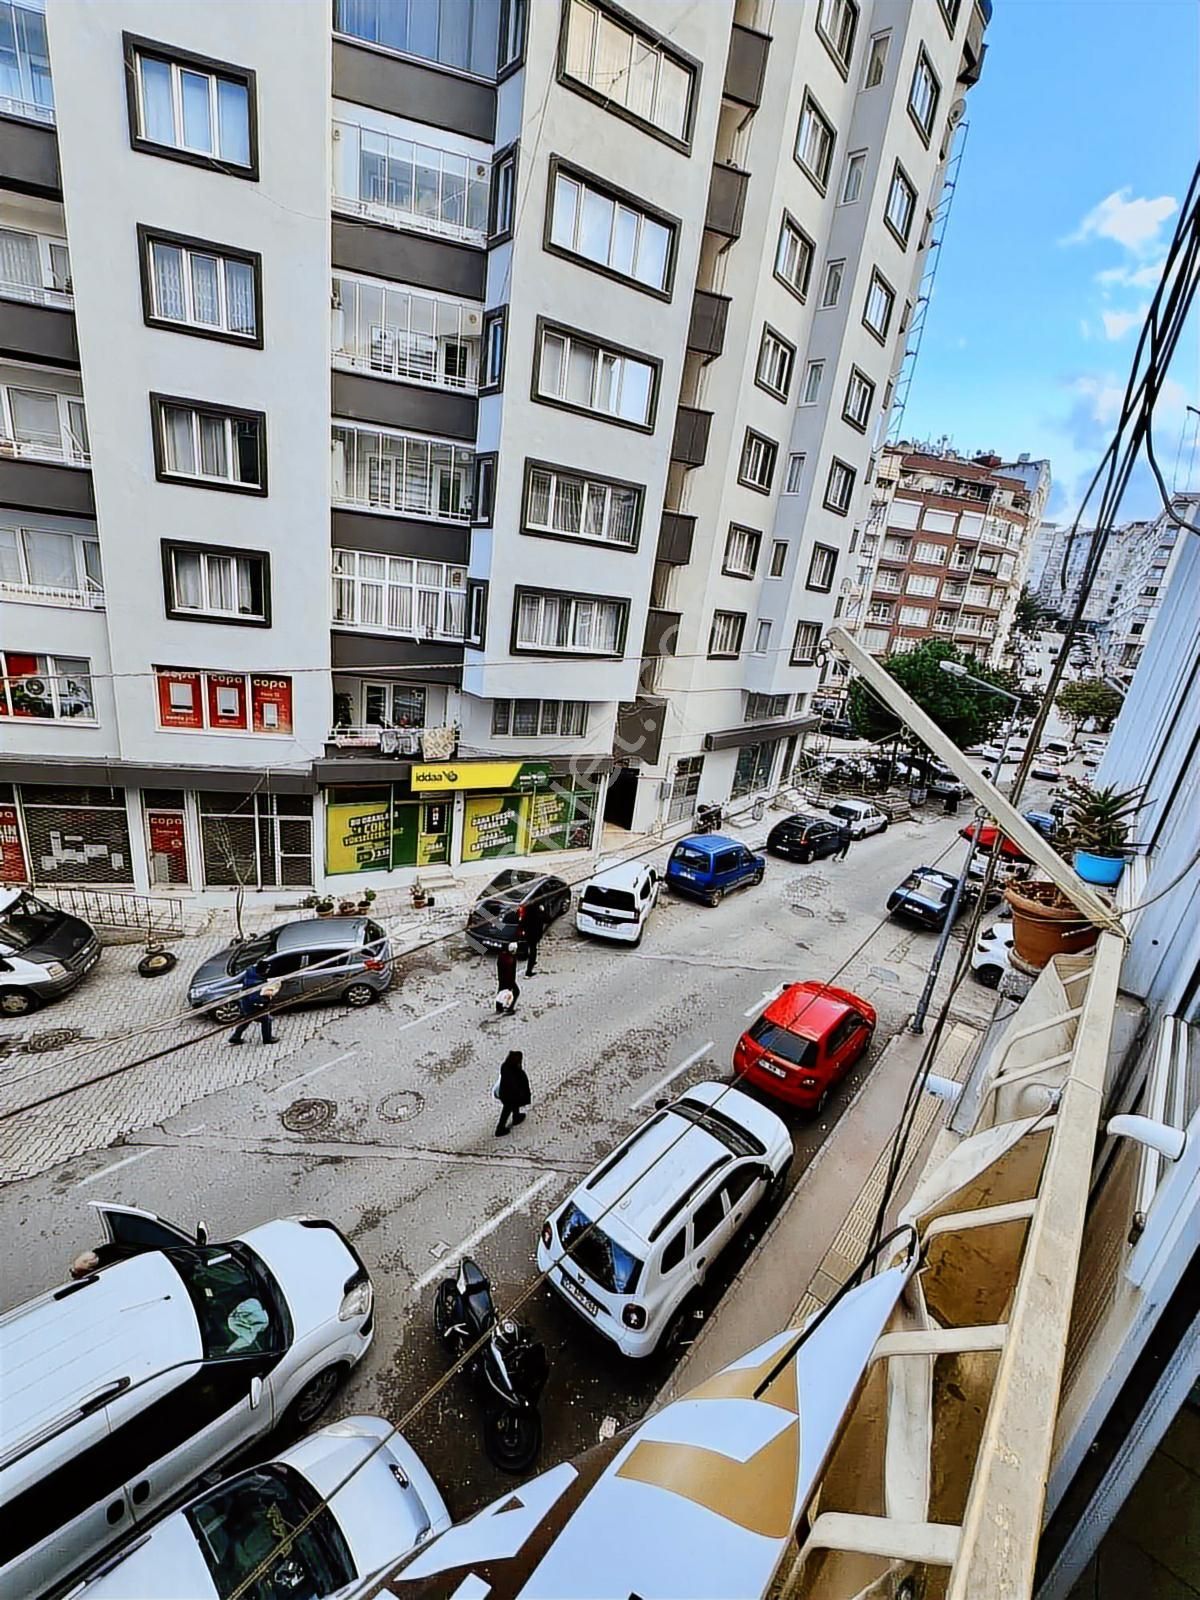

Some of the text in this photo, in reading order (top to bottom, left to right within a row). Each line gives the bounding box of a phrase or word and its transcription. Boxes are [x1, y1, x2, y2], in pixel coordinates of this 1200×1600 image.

[211, 674, 242, 685] copa
[253, 679, 287, 689] copa
[416, 772, 443, 782] iddaa
[151, 818, 182, 826] copa
